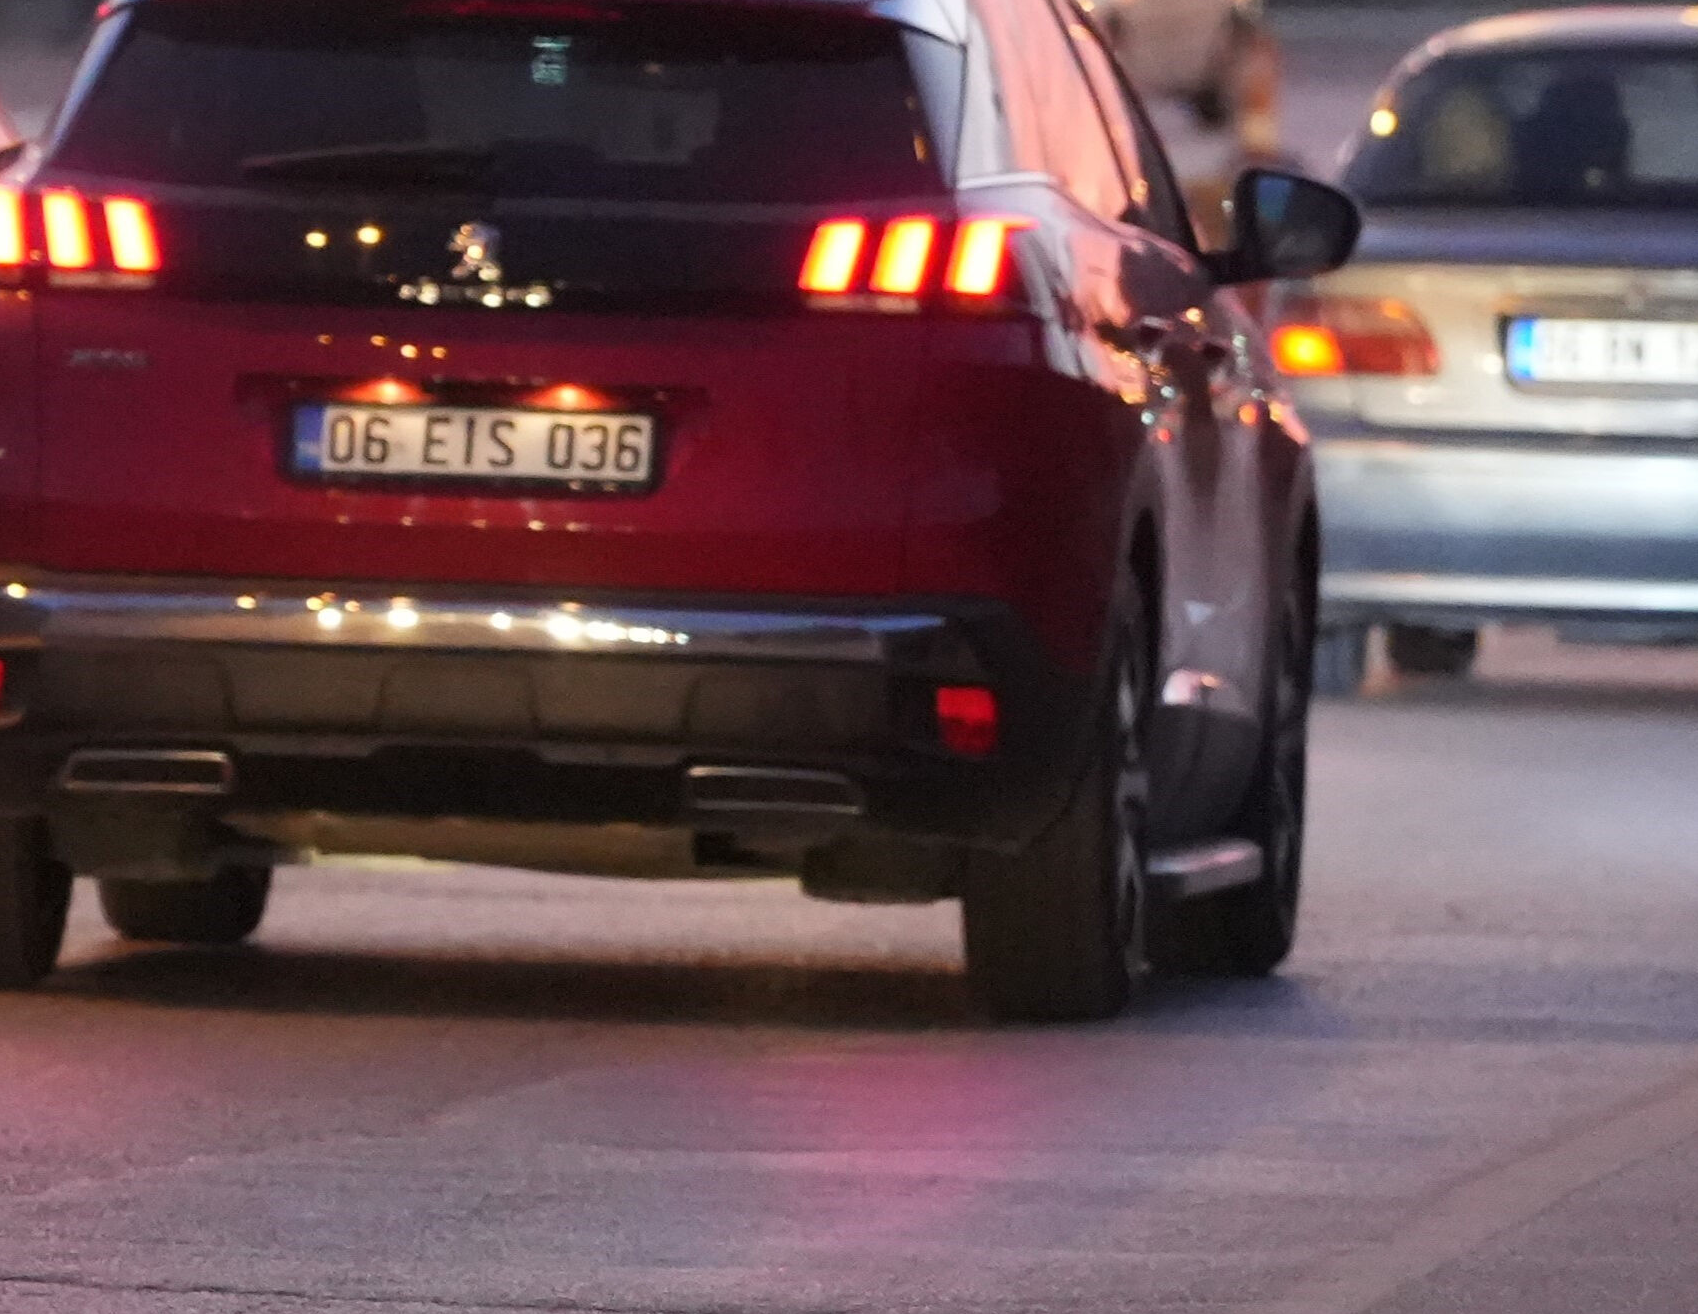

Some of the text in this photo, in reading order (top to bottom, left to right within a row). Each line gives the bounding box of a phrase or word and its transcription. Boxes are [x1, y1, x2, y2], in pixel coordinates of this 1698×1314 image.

[328, 414, 641, 473] 06 EIS 036
